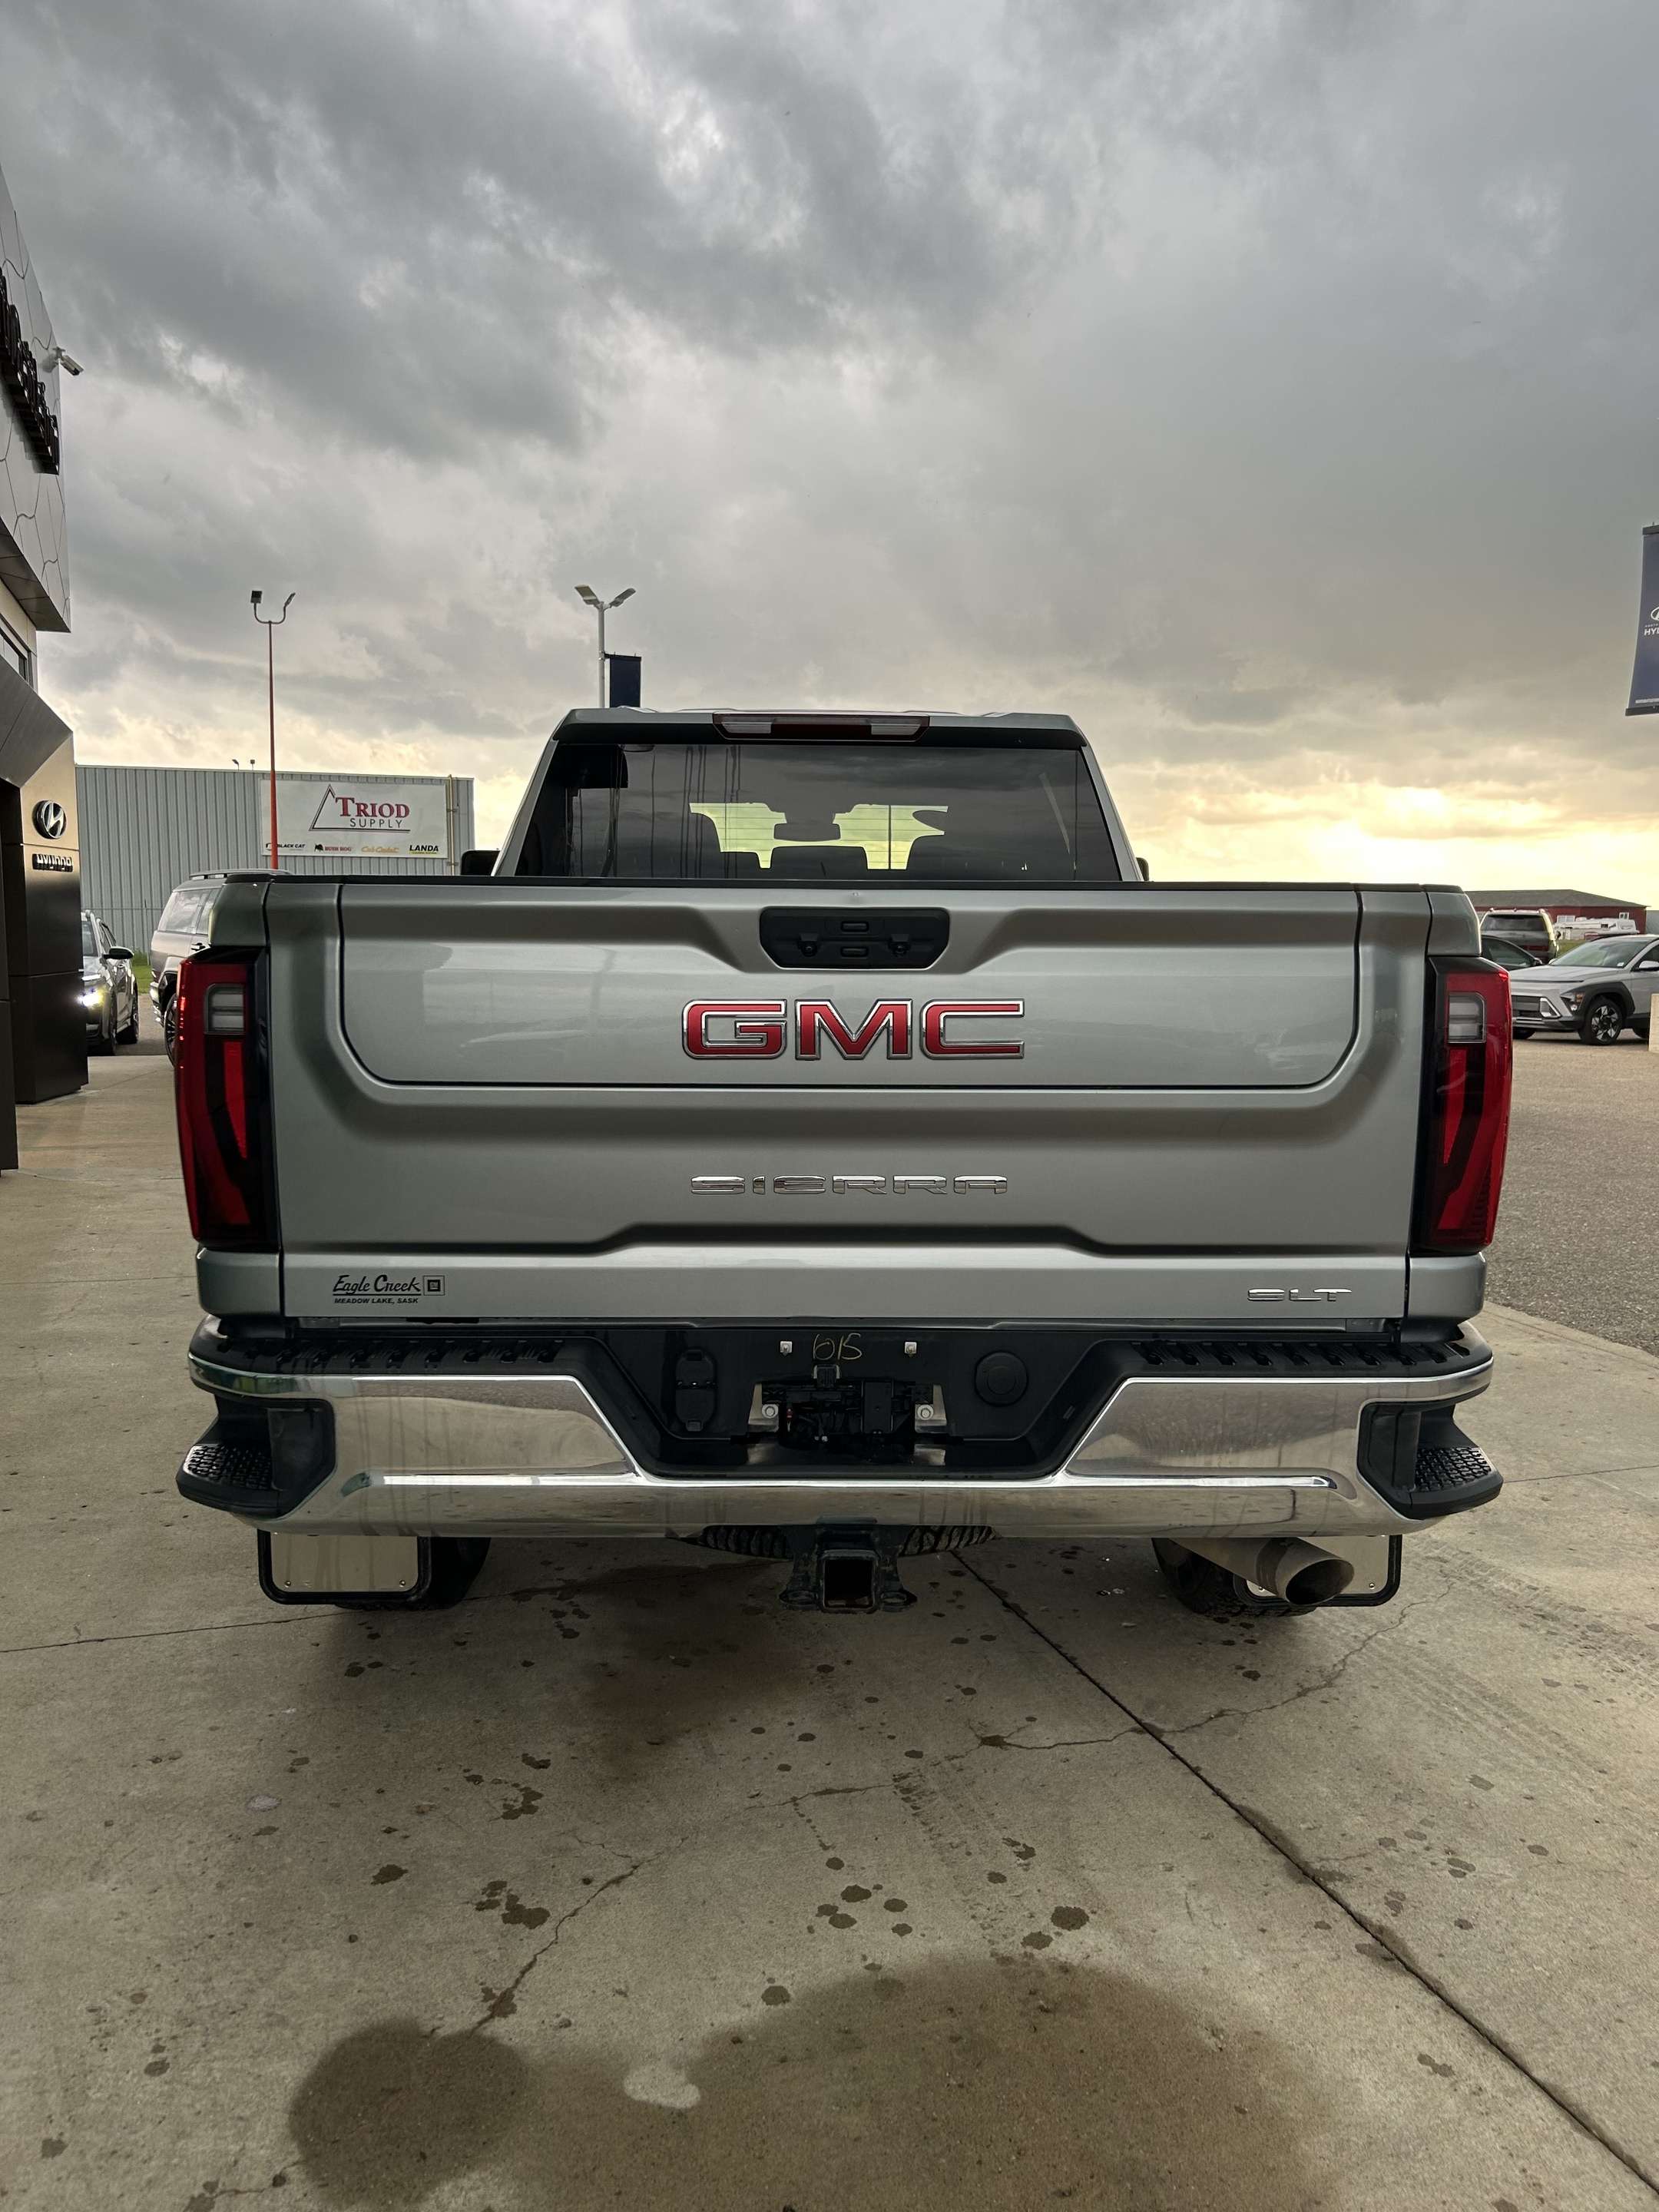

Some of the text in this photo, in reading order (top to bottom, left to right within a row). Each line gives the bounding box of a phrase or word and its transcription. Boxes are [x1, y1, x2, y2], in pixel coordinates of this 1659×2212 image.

[335, 796, 410, 818] TRIOD
[349, 818, 402, 828] SUPPLY
[682, 999, 1025, 1060] GMC
[691, 1175, 1008, 1194] SIERRA
[333, 1275, 370, 1293] Eagle
[374, 1275, 421, 1292] Creek
[1248, 1289, 1352, 1301] SLT
